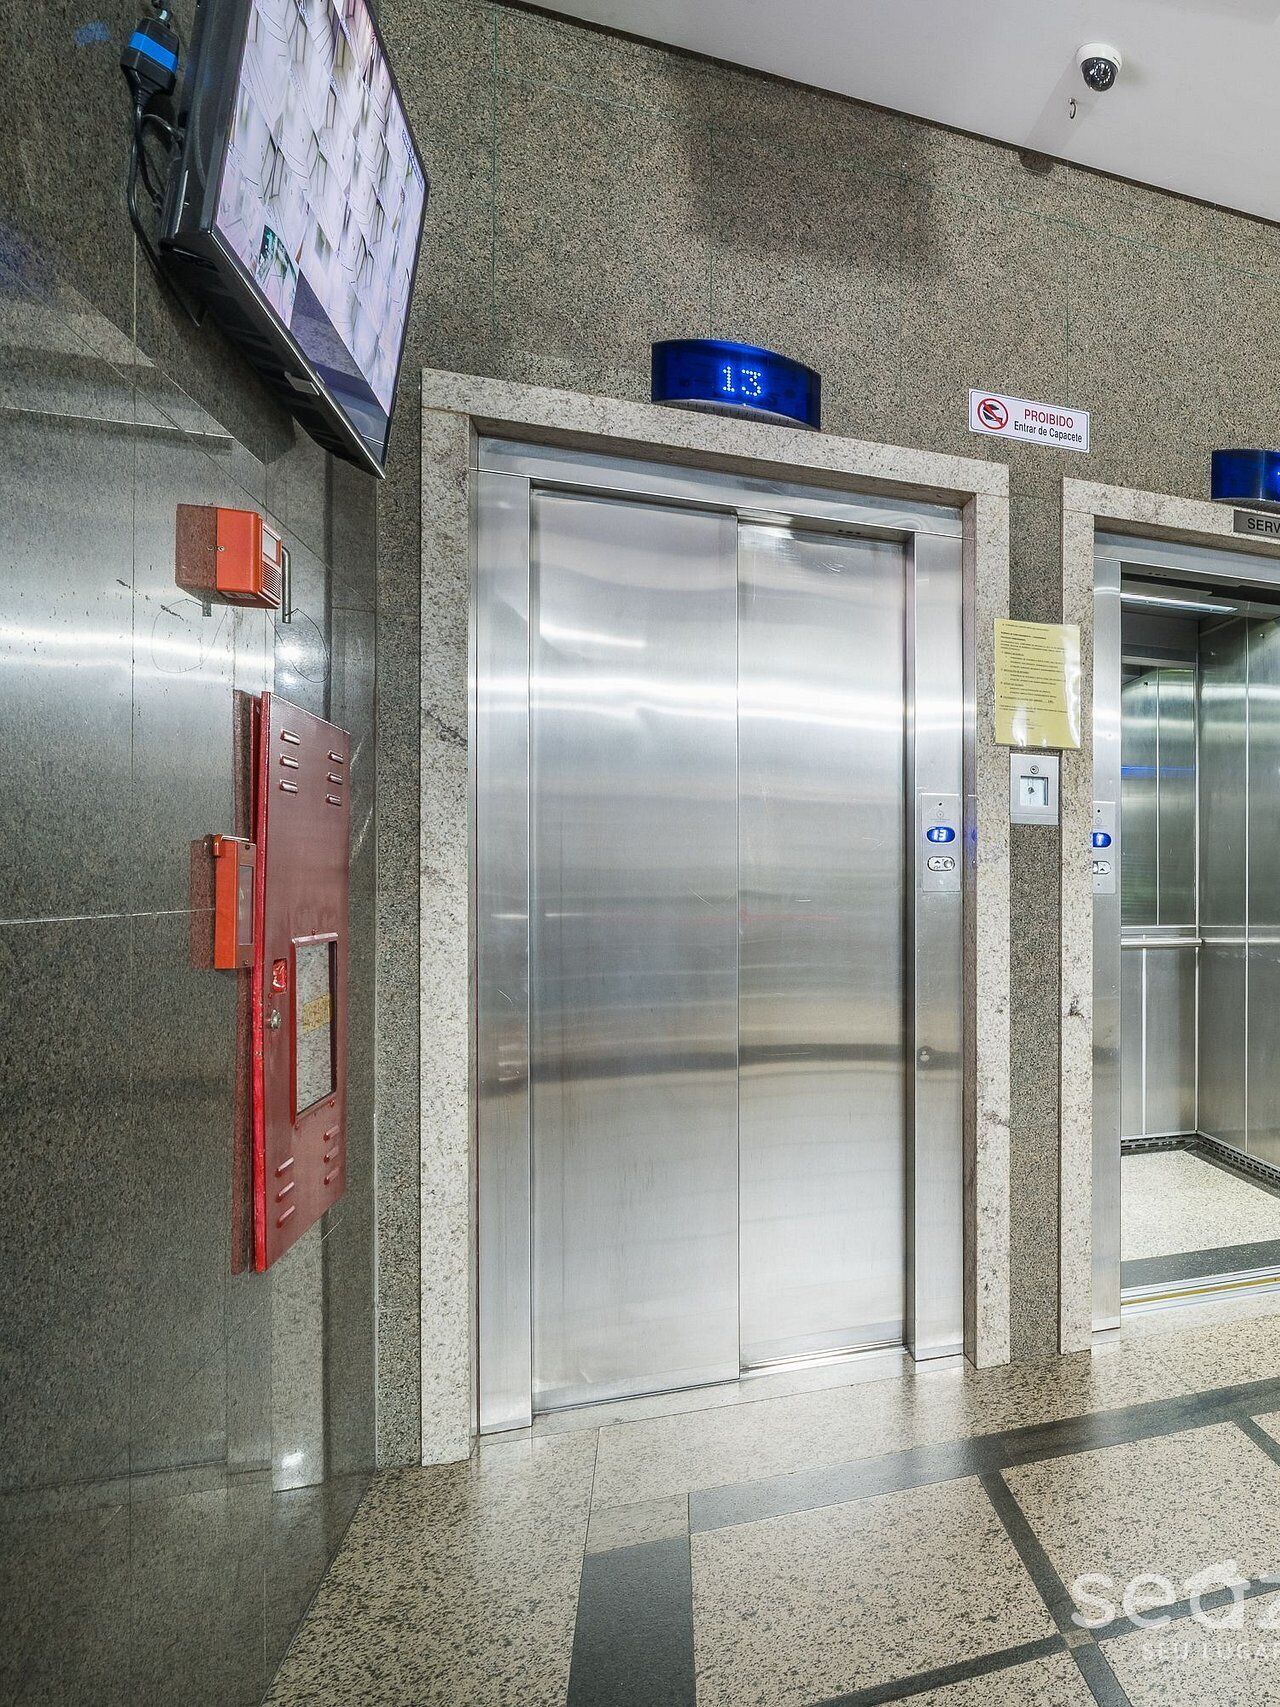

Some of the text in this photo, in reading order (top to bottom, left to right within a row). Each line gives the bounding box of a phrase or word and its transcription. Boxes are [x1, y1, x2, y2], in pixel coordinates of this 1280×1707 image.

[722, 365, 762, 398] 13
[1023, 407, 1074, 430] PROIBIDO
[1013, 420, 1083, 444] Entrar de Capacete
[932, 828, 948, 840] 13
